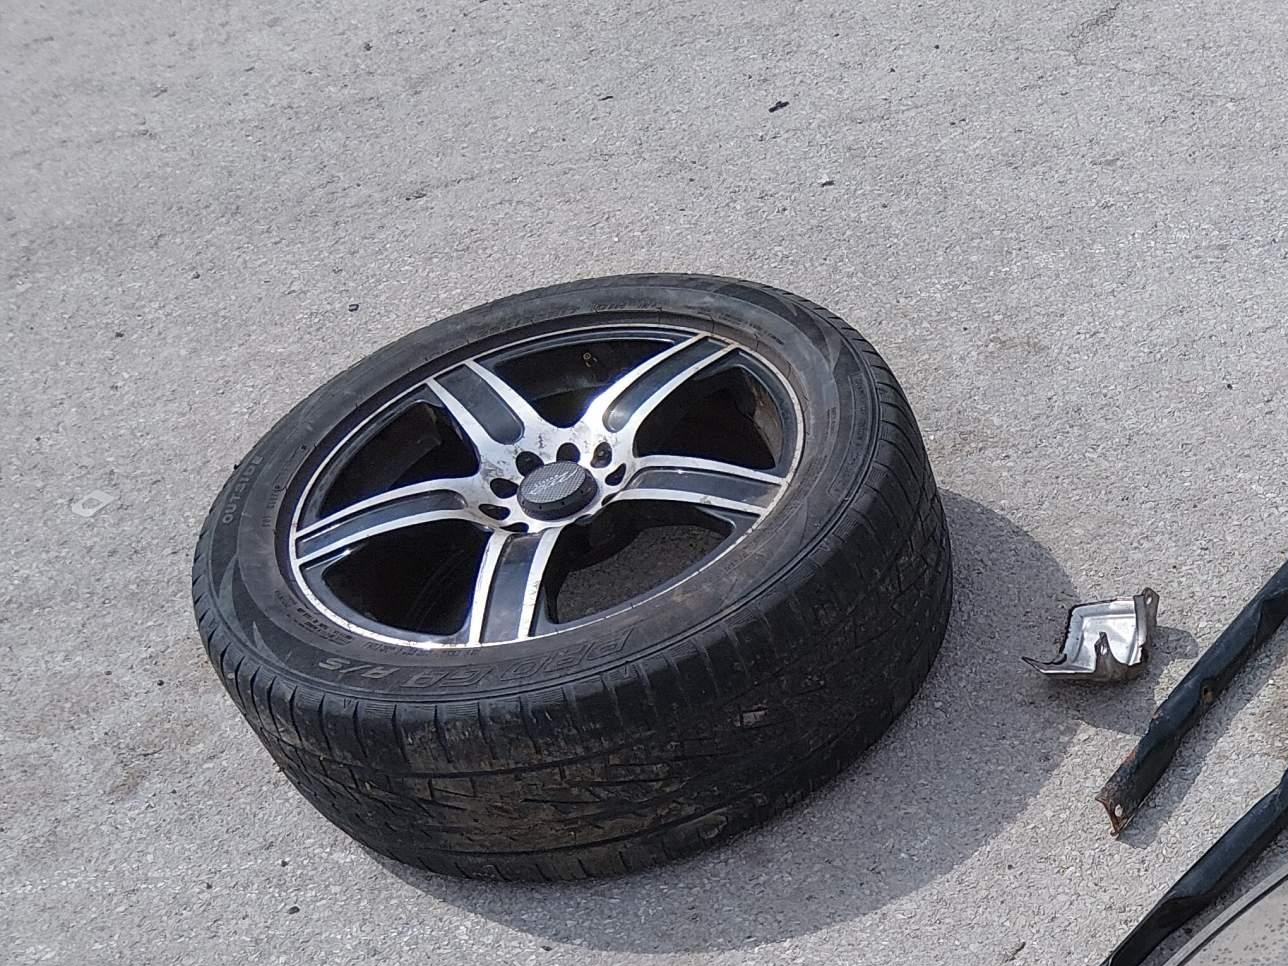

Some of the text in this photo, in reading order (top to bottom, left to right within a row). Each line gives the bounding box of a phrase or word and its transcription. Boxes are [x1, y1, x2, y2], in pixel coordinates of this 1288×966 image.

[222, 456, 264, 524] OUTSIDE
[317, 657, 400, 680] A/S
[500, 628, 635, 681] PRO
